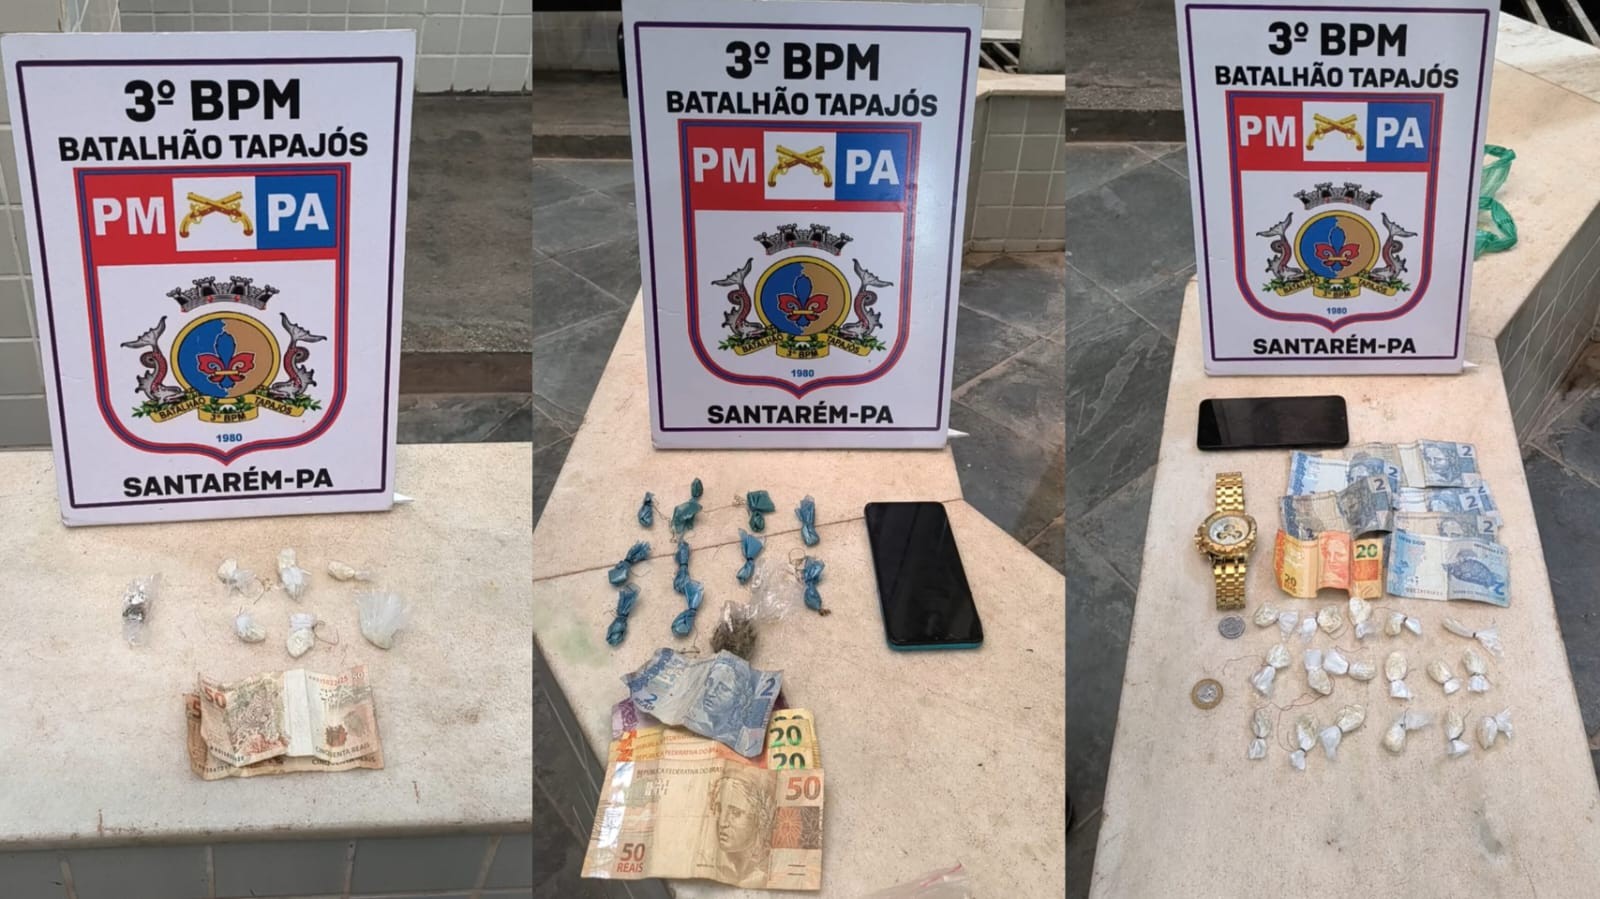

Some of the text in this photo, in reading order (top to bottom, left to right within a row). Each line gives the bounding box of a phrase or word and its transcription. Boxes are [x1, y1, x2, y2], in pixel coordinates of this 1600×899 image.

[1268, 21, 1408, 57] 3º BPM
[725, 40, 880, 81] 3º BPM
[1215, 62, 1459, 89] BATALHÃO TAPAJÓS
[124, 79, 300, 122] 3º BPM
[666, 87, 938, 117] BATALHÃO TAPAJÓS
[1239, 115, 1296, 148] PM
[1376, 116, 1425, 148] PA
[58, 127, 368, 162] BATALHÃO TAPAJÓS
[693, 147, 756, 184] PM
[846, 149, 900, 185] PA
[92, 196, 166, 236] PM
[267, 193, 329, 232] PA
[1326, 307, 1348, 315] 1980
[799, 349, 819, 359] BPM
[1253, 334, 1416, 355] SANTARÉM-PA
[791, 369, 815, 378] 1980
[224, 412, 246, 423] BPM
[707, 401, 894, 425] SANTARÉM-PA
[216, 433, 243, 442] 1980
[1462, 446, 1473, 456] 2
[123, 466, 334, 498] SANTARÉM-PA
[1389, 467, 1398, 478] 2
[1374, 478, 1386, 491] 2
[1465, 495, 1478, 508] 2
[1483, 521, 1494, 533] 2
[1356, 544, 1378, 559] 20
[760, 677, 776, 697] 2
[769, 725, 803, 749] 20
[773, 752, 806, 770] 20
[785, 775, 821, 801] 50
[620, 843, 645, 861] 50
[616, 863, 644, 873] REAIS
